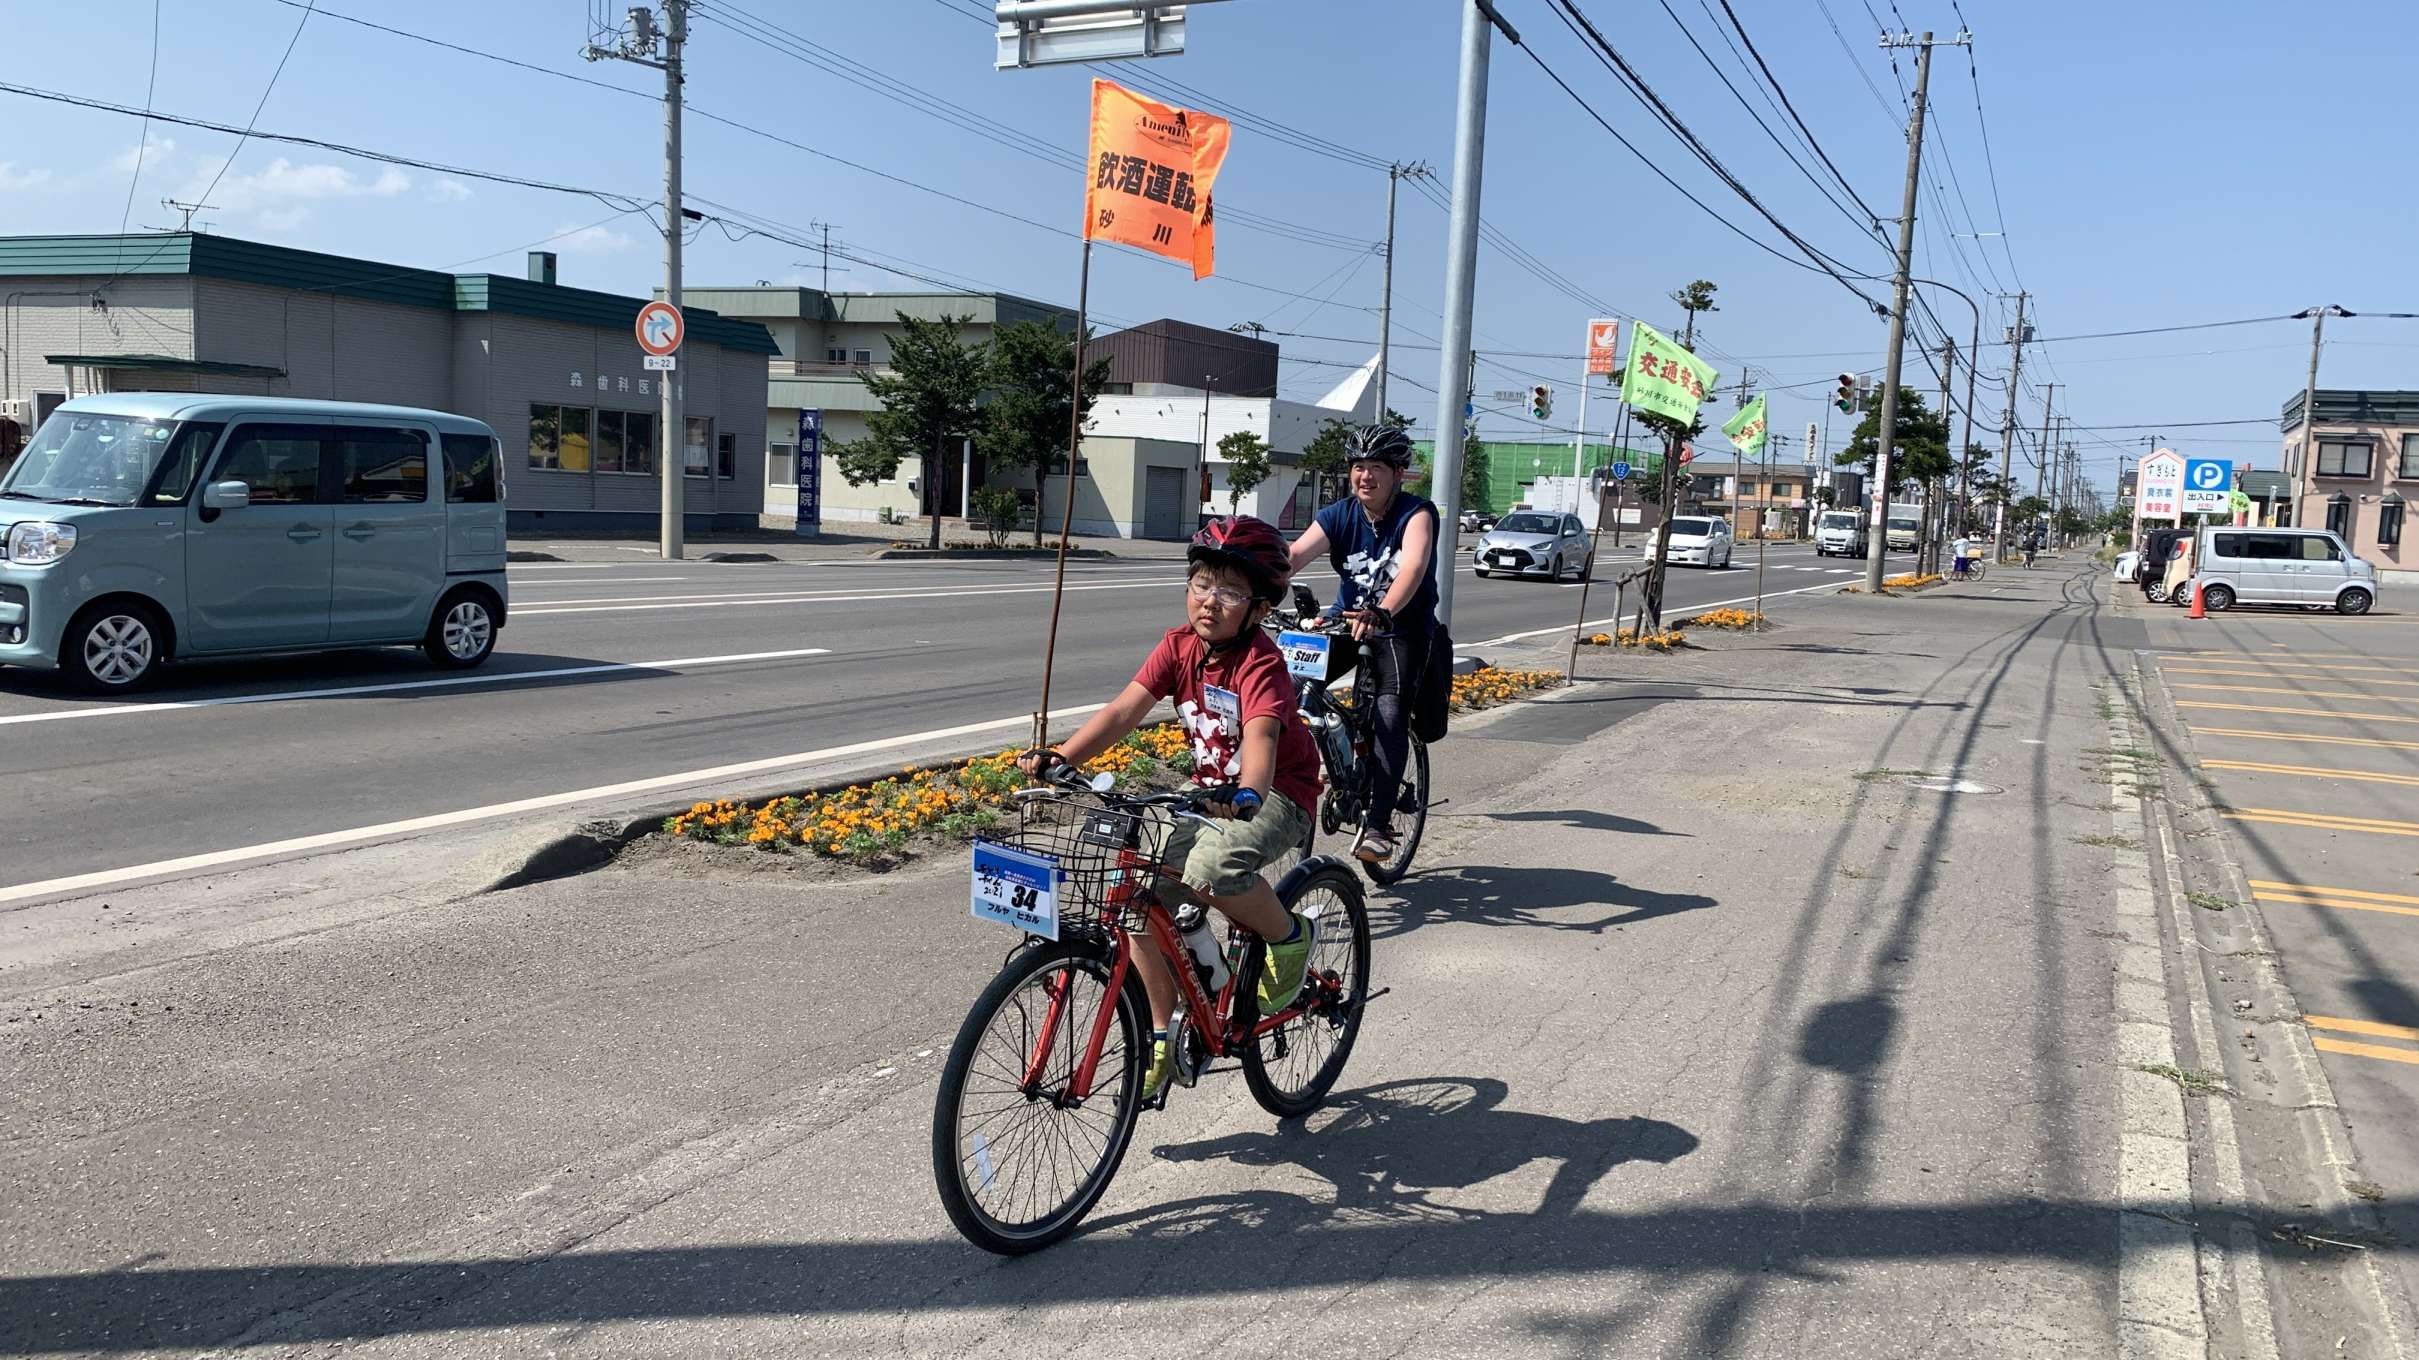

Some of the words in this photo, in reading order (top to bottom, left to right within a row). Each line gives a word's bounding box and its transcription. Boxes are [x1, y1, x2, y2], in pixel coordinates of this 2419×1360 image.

[1097, 151, 1213, 228] 飲酒運転
[1152, 223, 1173, 246] 川
[1637, 351, 1705, 399] 交通安全
[1617, 466, 1626, 475] 12
[2187, 493, 2214, 502] 出入口
[1294, 650, 1321, 664] Staff
[1011, 885, 1039, 912] 34
[987, 903, 1010, 916] フルヤ
[1016, 911, 1040, 925] ヒカル
